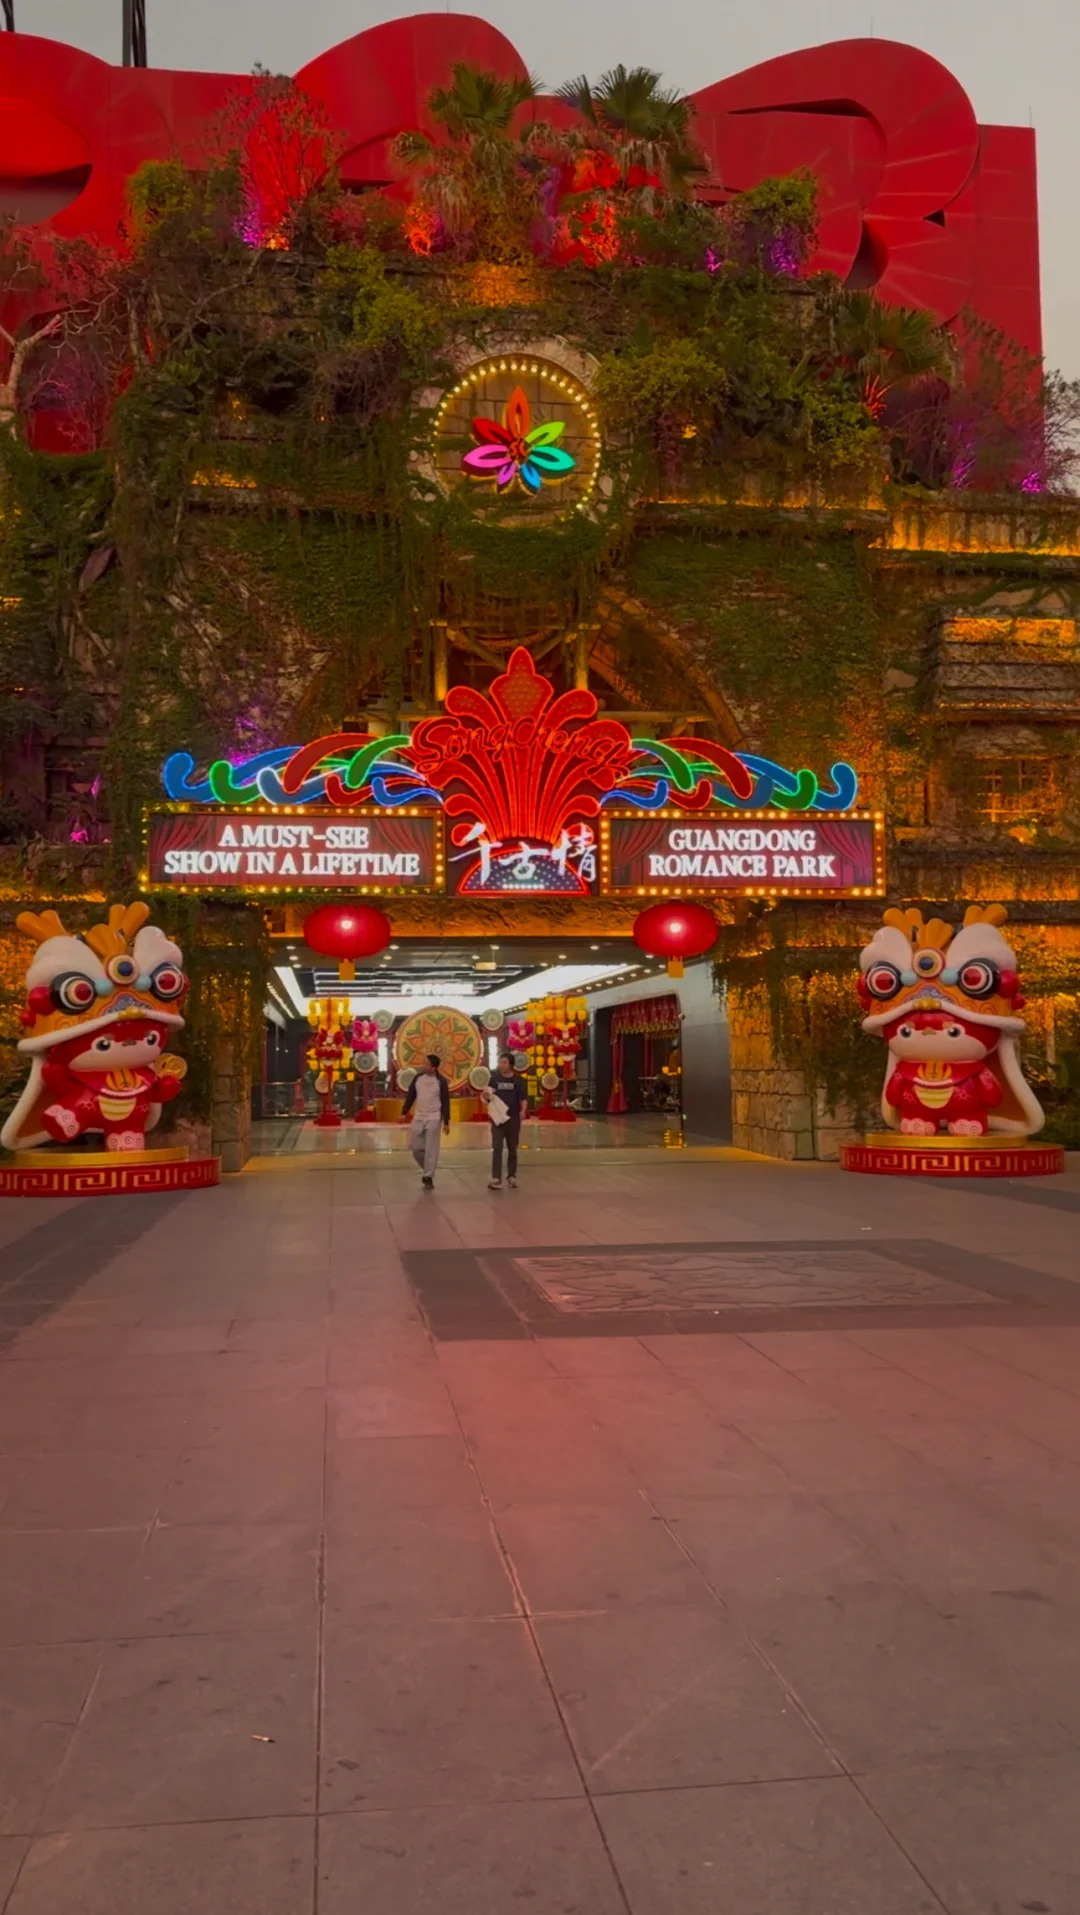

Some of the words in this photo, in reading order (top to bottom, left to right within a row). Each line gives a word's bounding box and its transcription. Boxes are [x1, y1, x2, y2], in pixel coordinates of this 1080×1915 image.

[219, 825, 238, 847] A
[241, 826, 369, 848] MUST-SEE
[668, 829, 816, 851] GUANGDONG
[164, 851, 241, 874] SHOW
[246, 852, 276, 875] IN
[278, 853, 298, 875] A
[302, 854, 420, 876] LIFETIME
[448, 821, 597, 885] 千古情
[649, 855, 767, 877] ROMANCE
[772, 855, 837, 877] PARK
